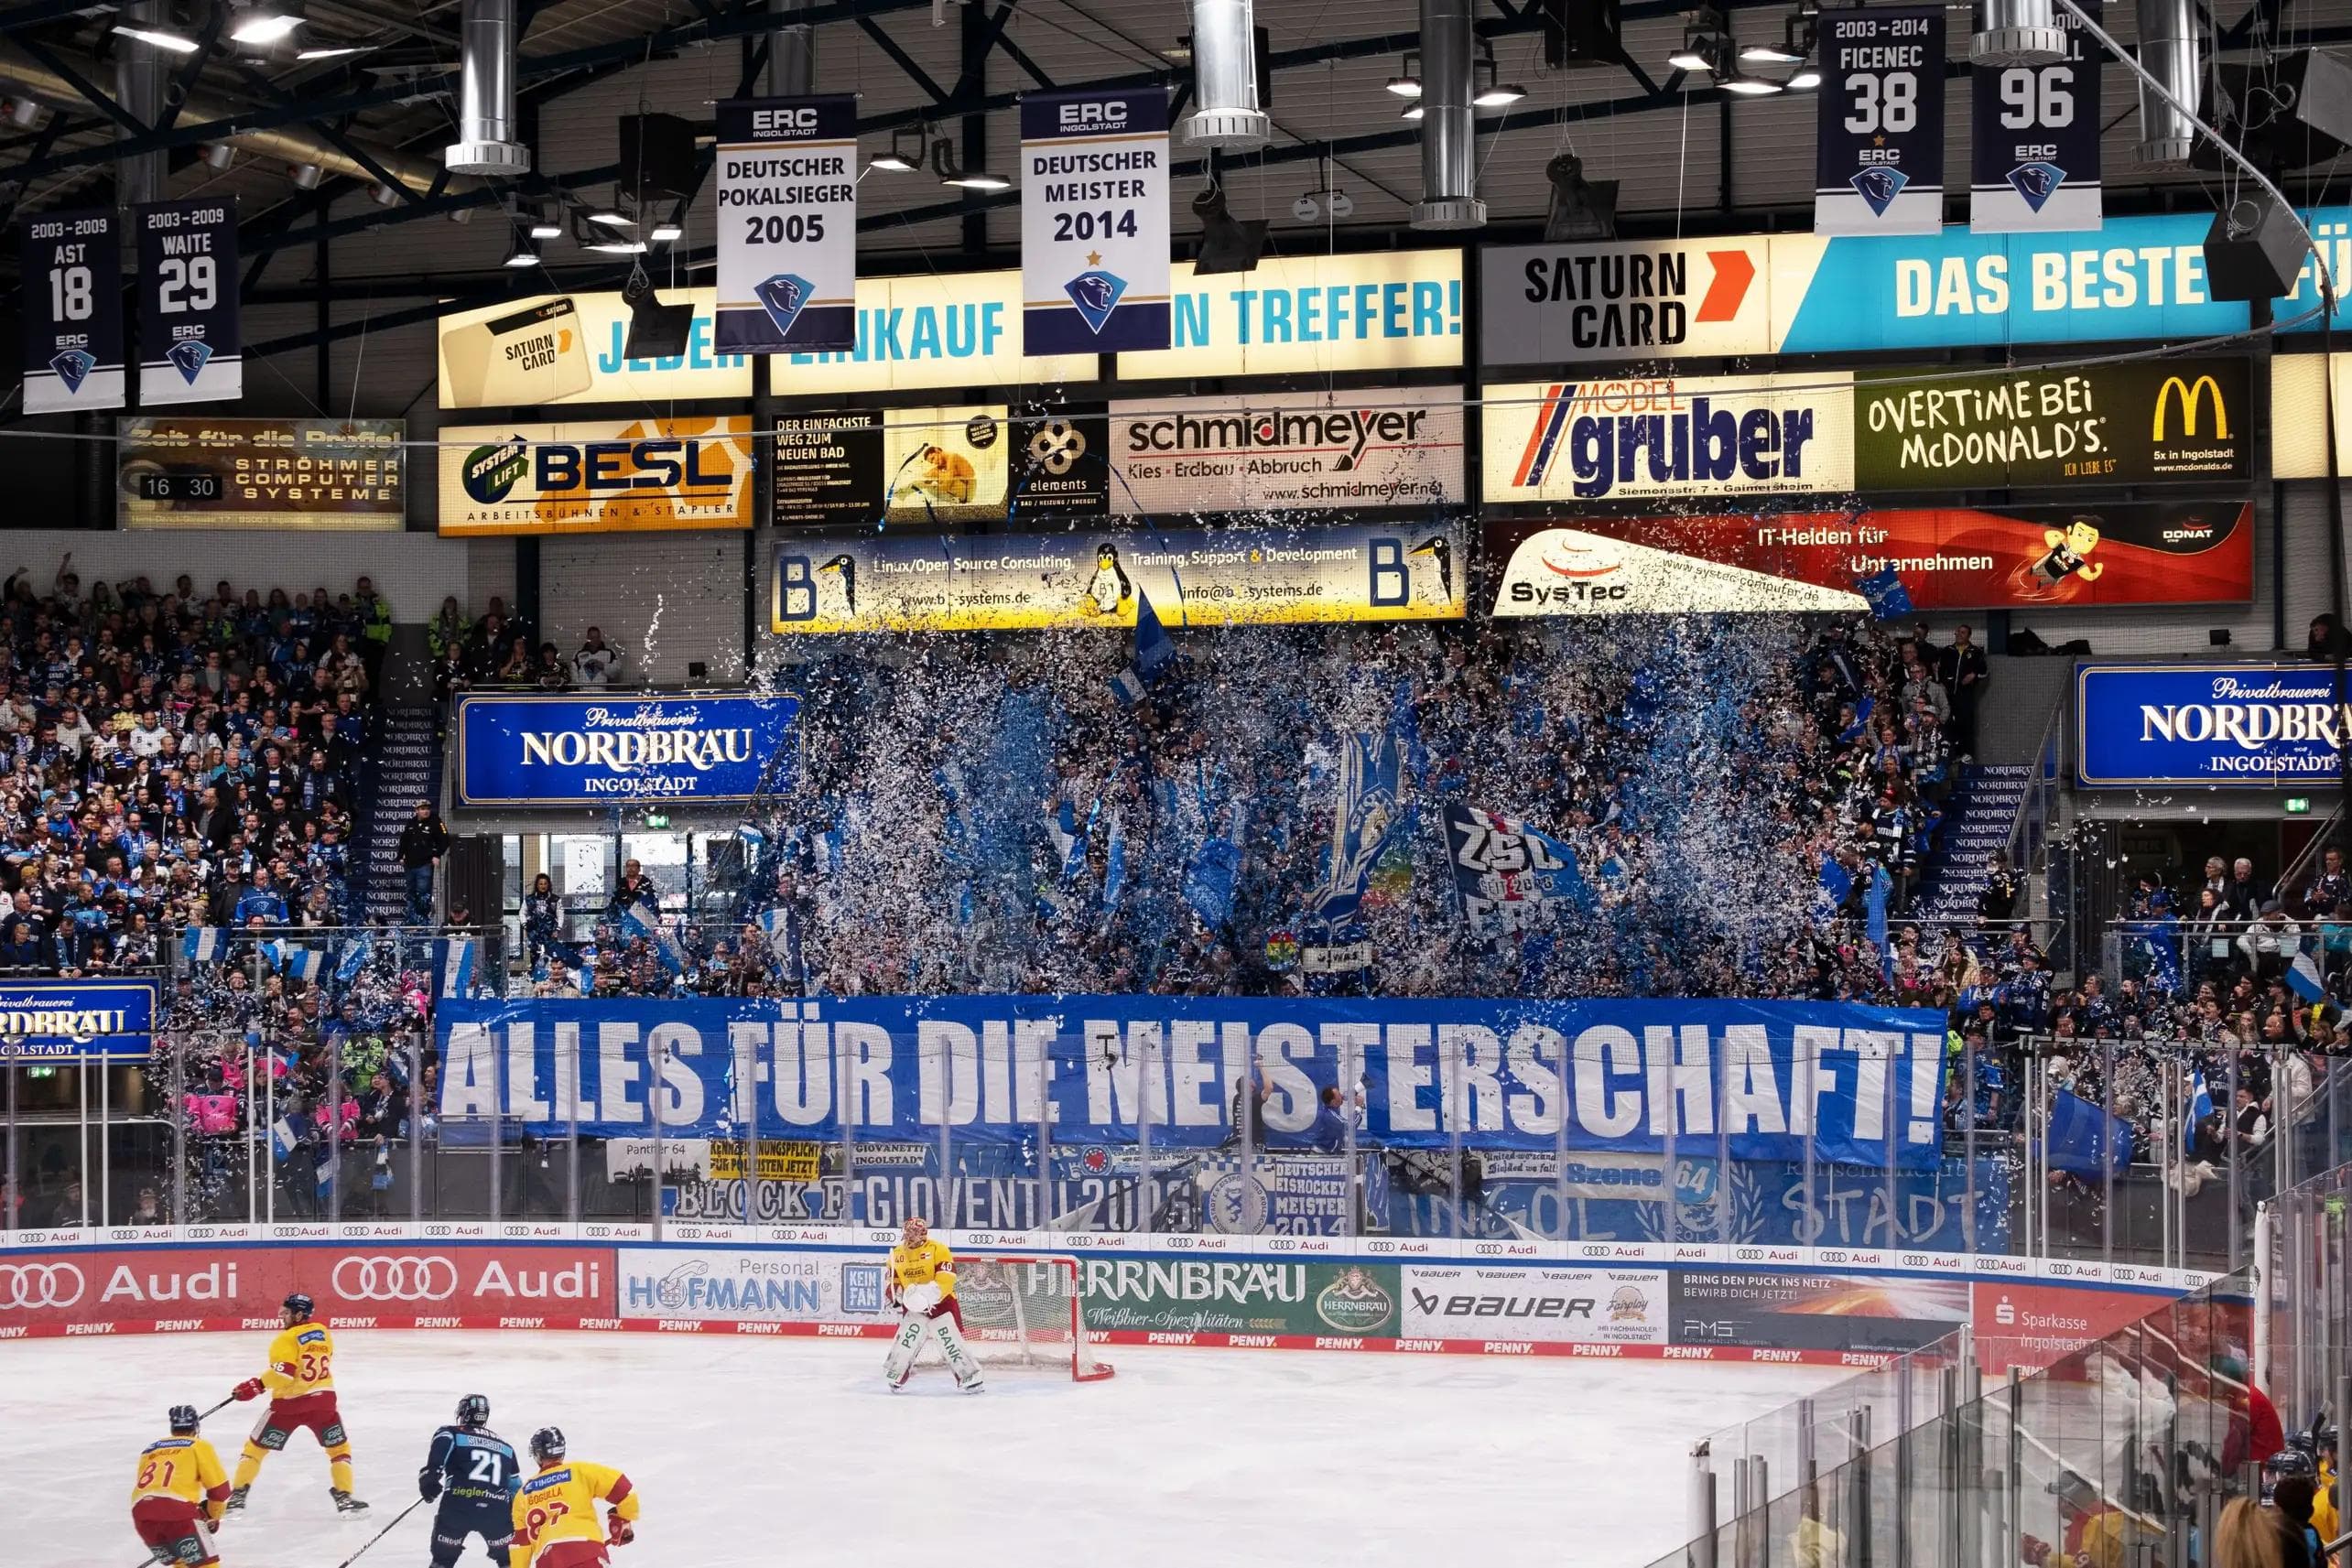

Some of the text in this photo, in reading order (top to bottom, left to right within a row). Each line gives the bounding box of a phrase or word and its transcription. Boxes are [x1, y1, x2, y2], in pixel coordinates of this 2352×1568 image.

[1840, 46, 1923, 70] FICENEC
[1844, 72, 1917, 134] 38
[2000, 67, 2074, 129] 96
[753, 109, 818, 129] ERC
[1059, 101, 1127, 124] ERC
[753, 128, 817, 137] INGOLSTADT
[1060, 122, 1127, 132] INGOLSTADT
[1859, 149, 1900, 161] ERC
[2016, 145, 2057, 156] ERC
[727, 157, 844, 178] DEUTSCHER
[1033, 150, 1157, 175] DEUTSCHER
[718, 184, 854, 206] POKALSIEGER
[1045, 179, 1146, 202] MEISTER
[745, 214, 824, 244] 2005
[1054, 210, 1138, 242] 2014
[55, 243, 86, 264] AST
[162, 232, 211, 255] WAITE
[158, 256, 216, 313] 29
[1525, 253, 1685, 303] SATURN
[1895, 245, 2205, 318] DAS BESTE
[49, 266, 92, 321] 18
[1230, 280, 1460, 347] TREFFER!
[173, 324, 205, 337] ERC
[1572, 301, 1686, 348] CARD
[56, 334, 88, 345] ERC
[505, 333, 554, 361] SATURN
[523, 350, 555, 371] CARD
[777, 416, 871, 432] DER EINFACHSTE
[777, 432, 831, 446] WEG ZUM
[1129, 408, 1426, 461] schmidmeyer
[777, 446, 845, 460] NEUEN BAD
[1571, 397, 1814, 498] gruber
[2153, 449, 2234, 460] 5x in Ingolstadt
[235, 457, 398, 470] STRÖHMER
[471, 444, 519, 479] SYSTEM
[536, 440, 732, 491] BESL
[1129, 459, 1322, 480] Kies Erdbau Abbruch
[2065, 460, 2100, 476] ICH LIEBE
[2153, 462, 2232, 471] www.mcdonalds.de
[235, 473, 398, 485] COMPUTER
[493, 462, 519, 488] LIFT
[147, 479, 213, 496] 16 30
[244, 488, 390, 500] SYSTEME
[1031, 480, 1087, 491] elements
[1723, 482, 1813, 492] Gaimersheim
[655, 504, 732, 515] STAPLER
[1759, 527, 1890, 546] IT-Helden für
[2162, 530, 2213, 538] DONAT
[874, 557, 1075, 574] Linux/Open Source Consulting,
[1132, 548, 1357, 568] Training, Support & Development
[1851, 554, 1992, 572] Unternehmen
[1512, 582, 1625, 605] SysTec
[2211, 677, 2332, 699] Privatbrauerei
[586, 708, 699, 728] Privatbrauerei
[520, 729, 752, 773] NORDBRÄU
[2211, 756, 2332, 771] INGOLSTADT
[585, 777, 697, 793] INGOLSTADT
[440, 1001, 1946, 1145] ALLES FÜR DIE MEISTERSCHAFT!
[626, 1144, 685, 1155] Panther 64
[1276, 1162, 1348, 1176] DEUTSCHER
[1567, 1161, 1709, 1194] Szene 64
[1276, 1178, 1346, 1195] EISHOCKEY
[673, 1180, 811, 1219] BLOCK
[1276, 1197, 1347, 1216] MEISTER
[143, 1230, 172, 1238] Audi
[374, 1227, 402, 1236] Audi
[615, 1227, 640, 1237] Audi
[1276, 1217, 1348, 1236] 2014
[999, 1235, 1025, 1245] Audi
[1301, 1240, 1328, 1250] Audi
[1615, 1247, 1644, 1257] Audi
[1852, 1253, 1881, 1264] Audi
[740, 1260, 819, 1275] Personal
[941, 1262, 952, 1271] 40
[2076, 1267, 2101, 1278] Audi
[100, 1263, 237, 1302] Audi
[473, 1260, 599, 1298] Audi
[850, 1271, 876, 1286] KEIN
[1684, 1275, 1831, 1289] BRING DEN PUCK INS NETZ
[629, 1276, 820, 1312] HOFMANN
[850, 1290, 876, 1306] FAN
[1684, 1288, 1797, 1300] BEWIRB DICH JETZT!
[1444, 1296, 1595, 1318] BAUER
[2021, 1312, 2087, 1332] Sparkasse
[902, 1323, 920, 1348] PSD
[938, 1326, 962, 1362] BANK
[300, 1355, 330, 1382] 36
[137, 1460, 174, 1488] 81
[469, 1450, 502, 1487] 21
[526, 1502, 570, 1541] 87
